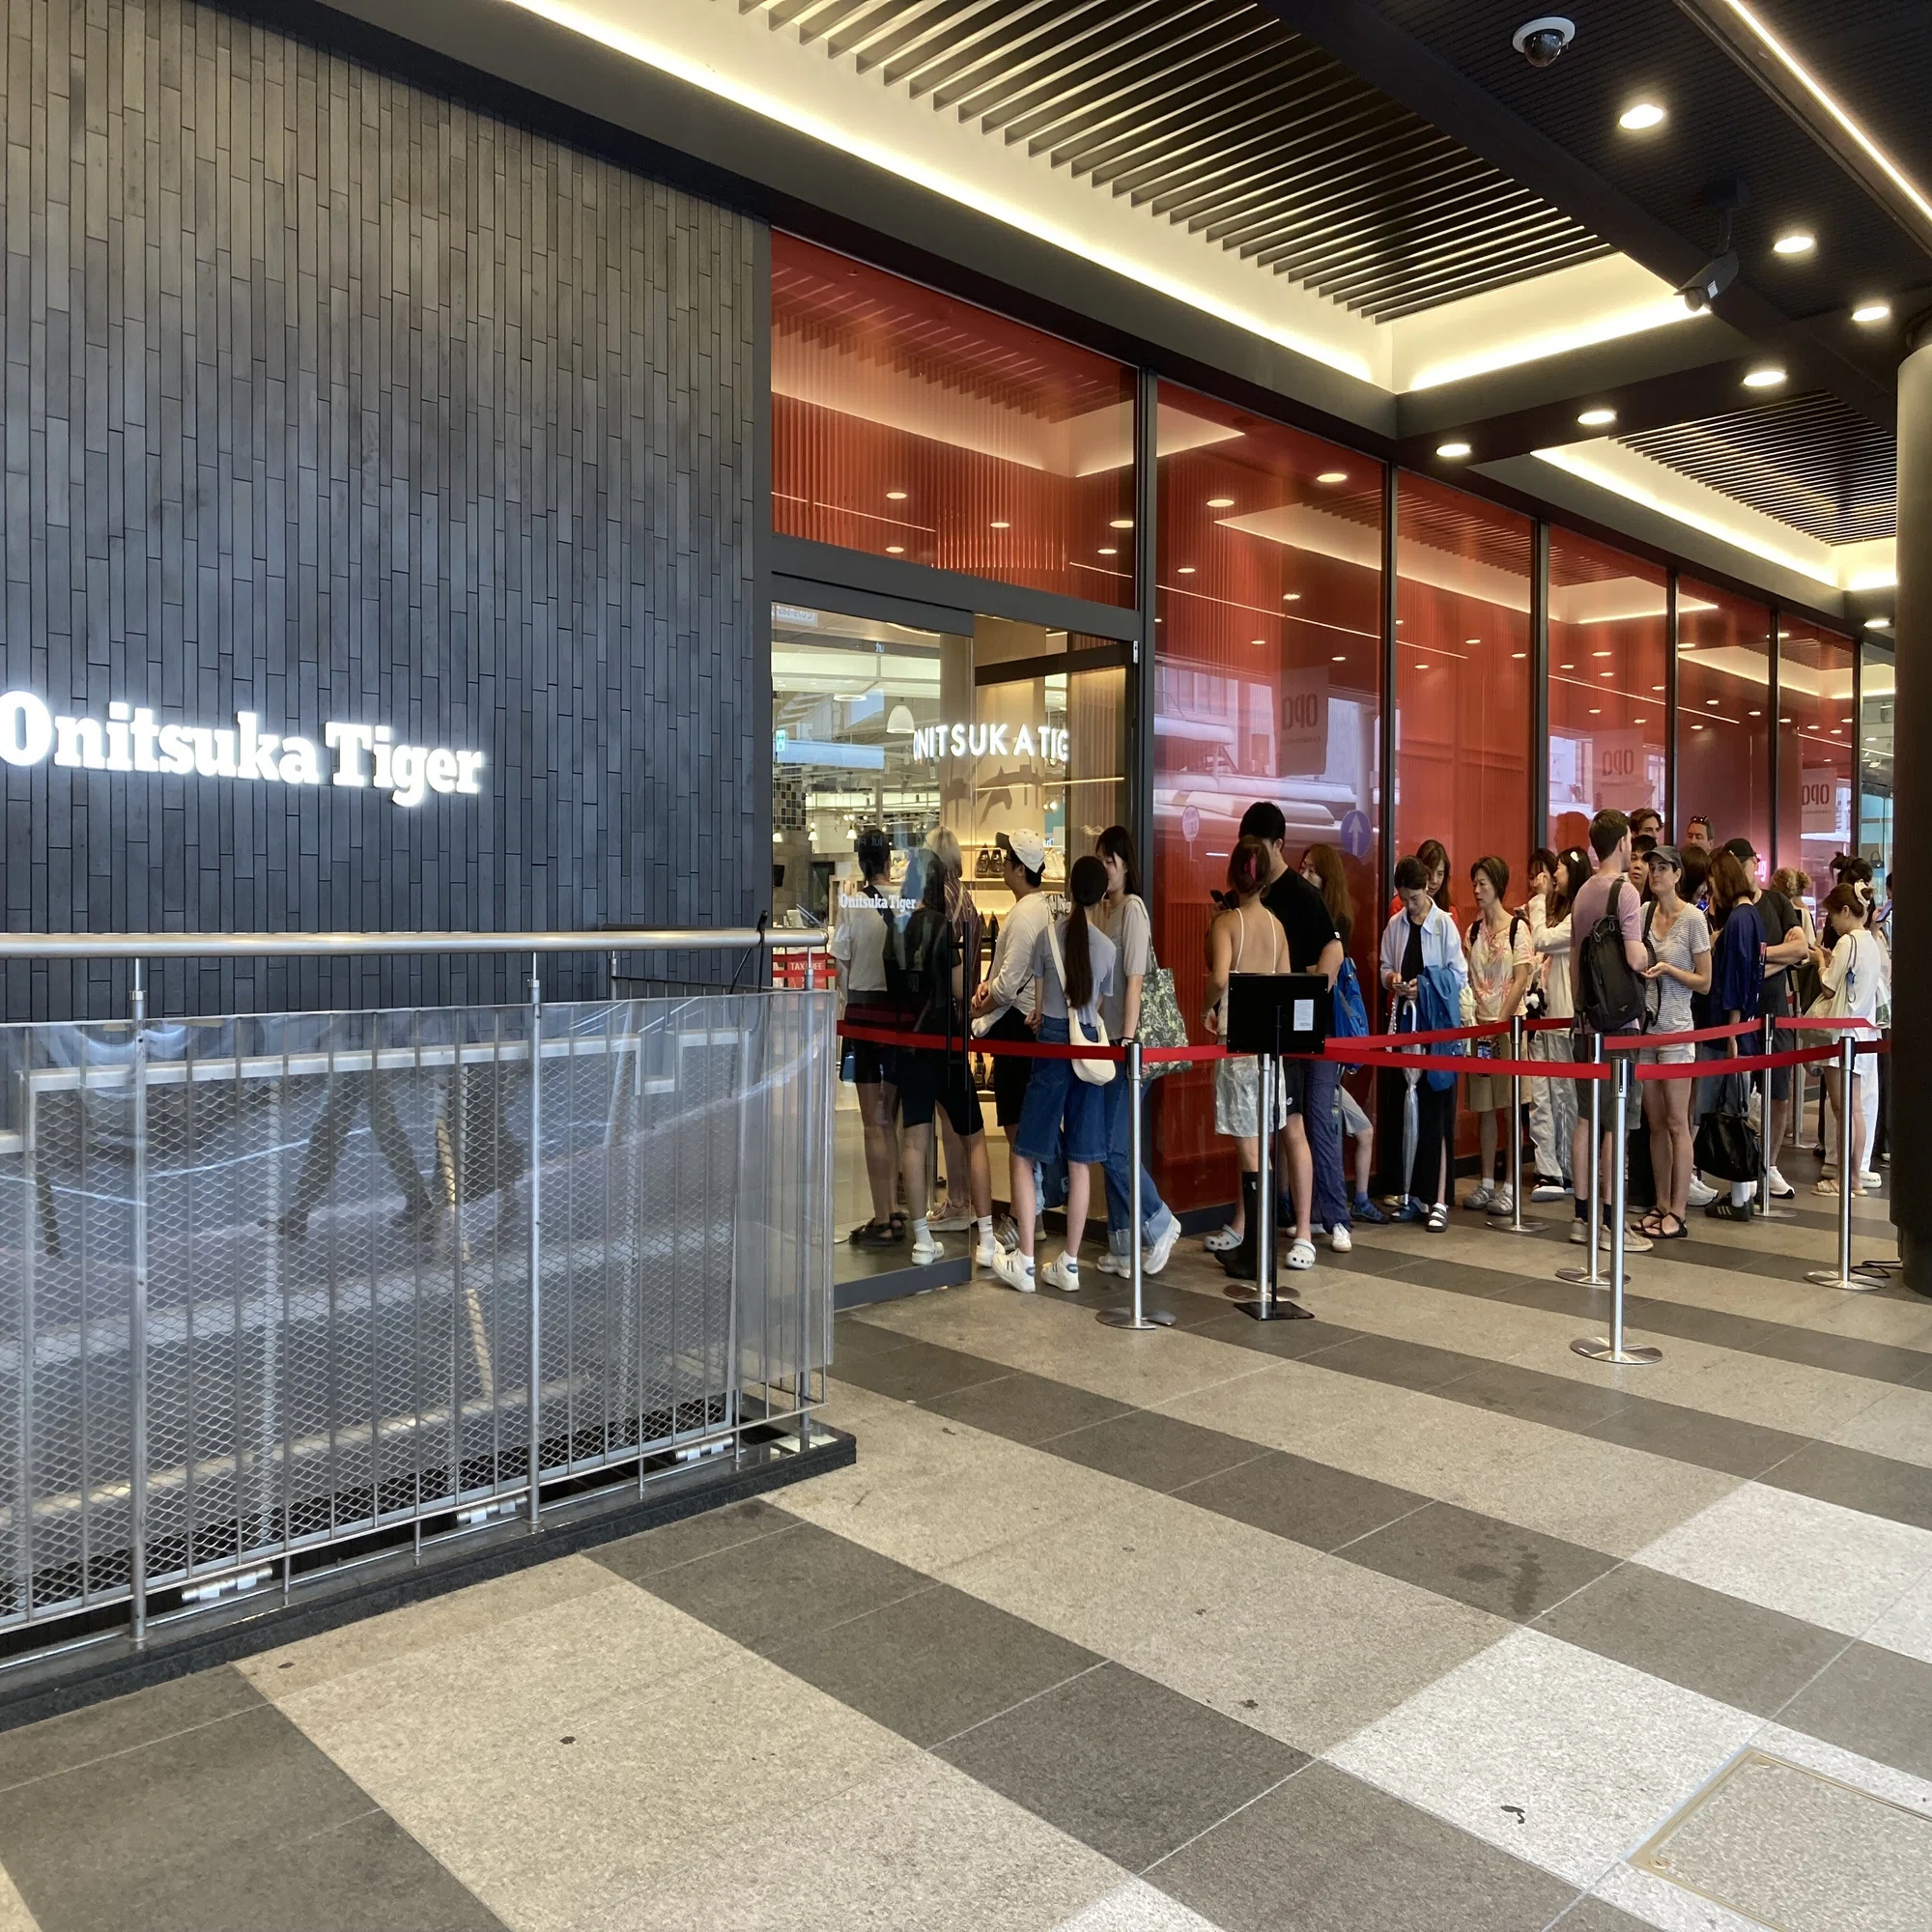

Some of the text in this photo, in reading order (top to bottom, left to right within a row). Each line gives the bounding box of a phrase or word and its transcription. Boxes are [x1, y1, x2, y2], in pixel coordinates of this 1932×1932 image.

[0, 691, 484, 807] Onitsuka Tiger
[839, 894, 916, 913] Onitsuka Tiger
[790, 962, 805, 971] TAX
